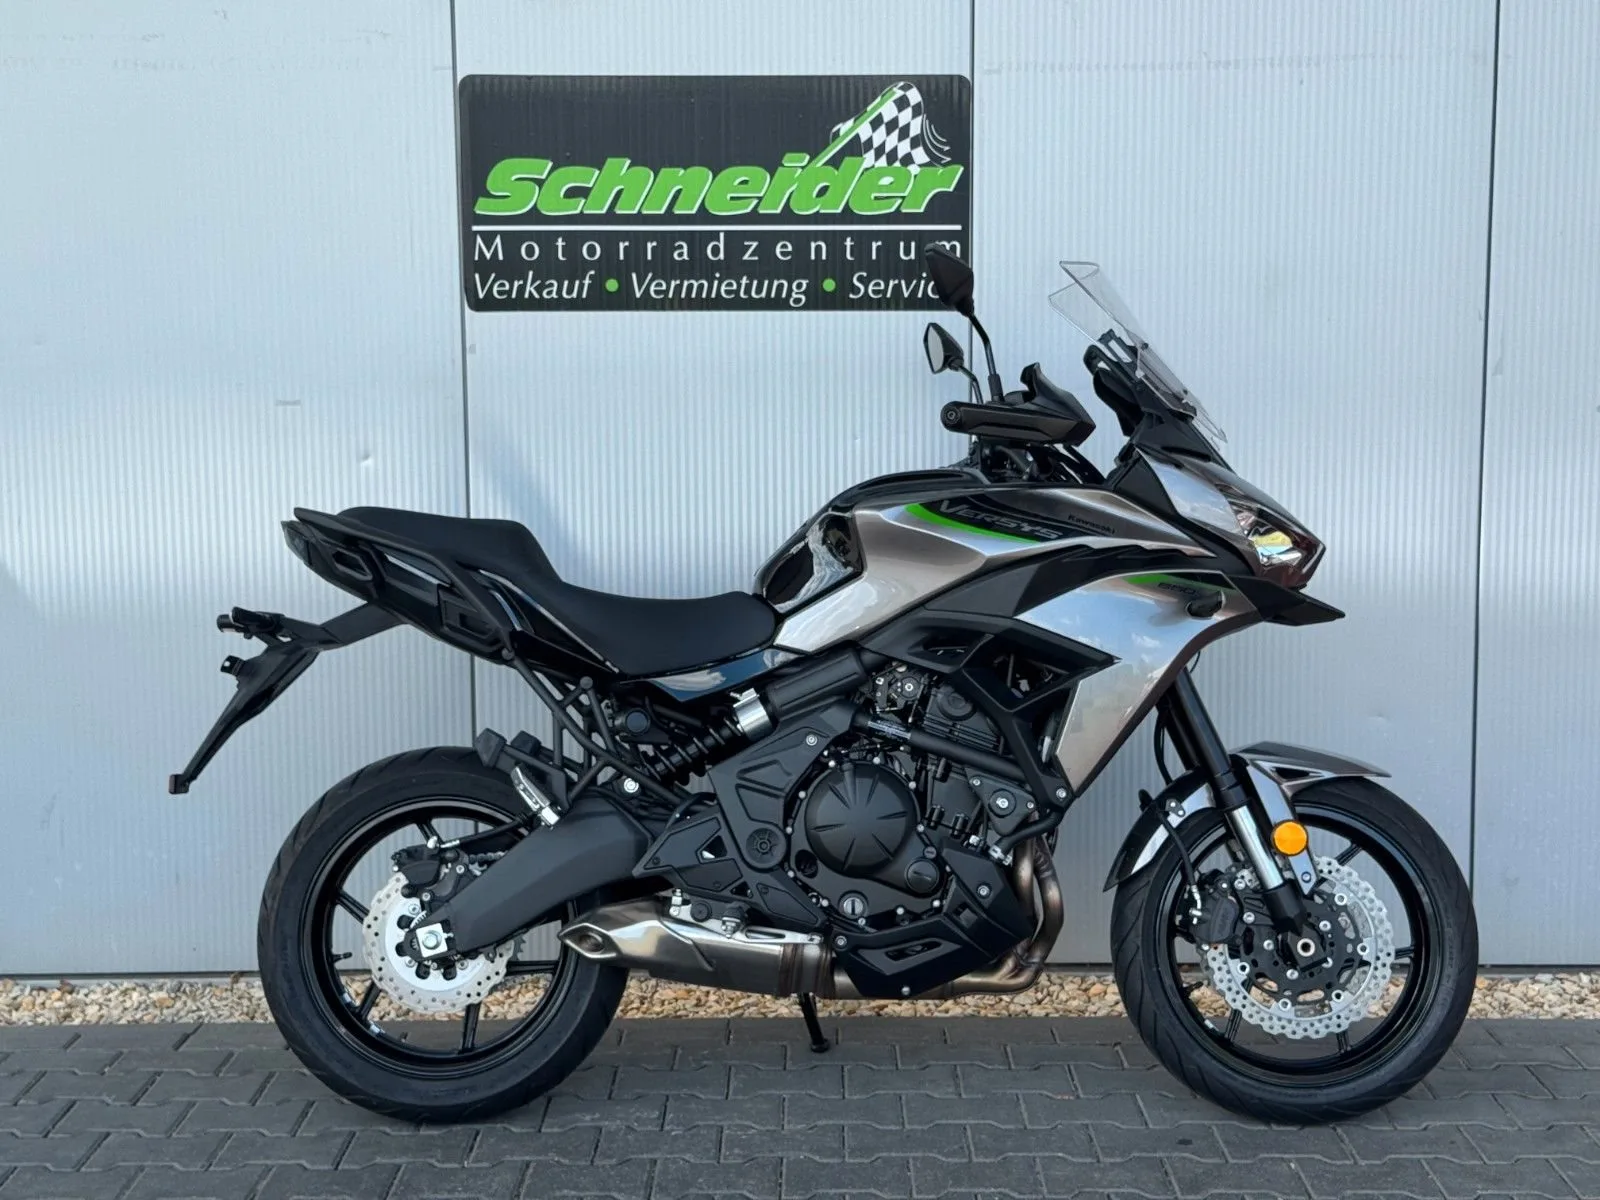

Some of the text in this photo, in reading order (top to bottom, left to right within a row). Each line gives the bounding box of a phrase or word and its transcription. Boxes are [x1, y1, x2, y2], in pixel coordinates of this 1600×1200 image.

[473, 152, 964, 216] Schneider
[474, 232, 961, 261] Motorradzentrum
[474, 270, 940, 308] Verkauf Vermietung Servic
[1067, 513, 1116, 535] Kawasaki
